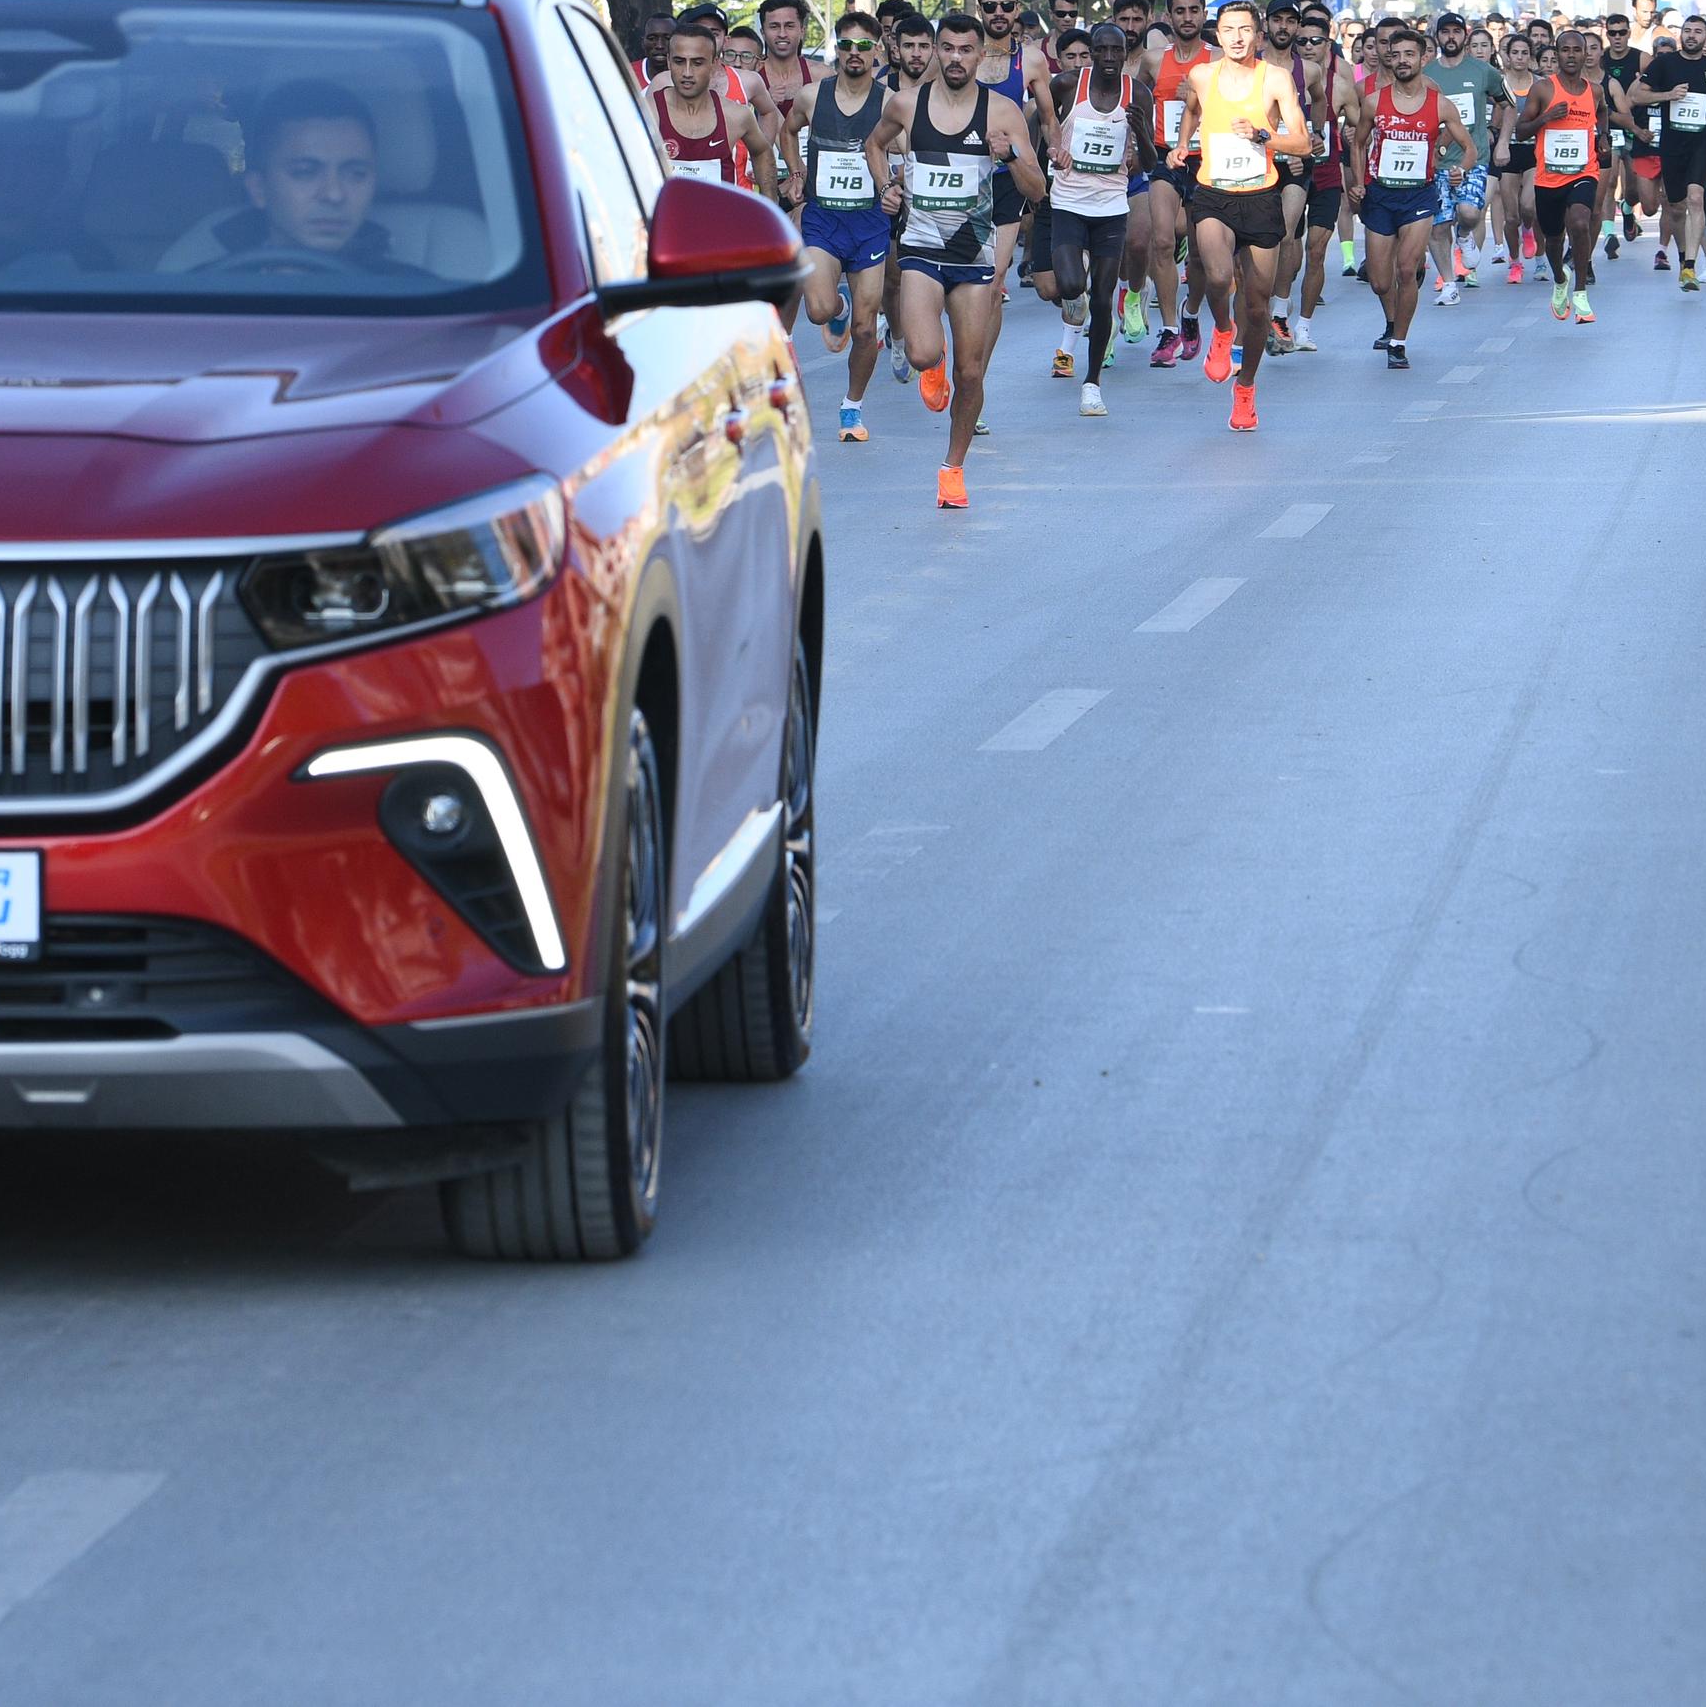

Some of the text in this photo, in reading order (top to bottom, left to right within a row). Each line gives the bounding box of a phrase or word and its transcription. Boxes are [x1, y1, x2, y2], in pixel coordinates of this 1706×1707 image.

[1677, 107, 1700, 119] 216
[1384, 129, 1428, 141] TÜRKİYE
[1082, 141, 1114, 157] 135
[1554, 147, 1579, 158] 189
[1225, 156, 1251, 170] 191
[1393, 160, 1415, 172] 117
[829, 175, 862, 190] 148
[928, 171, 963, 188] 178
